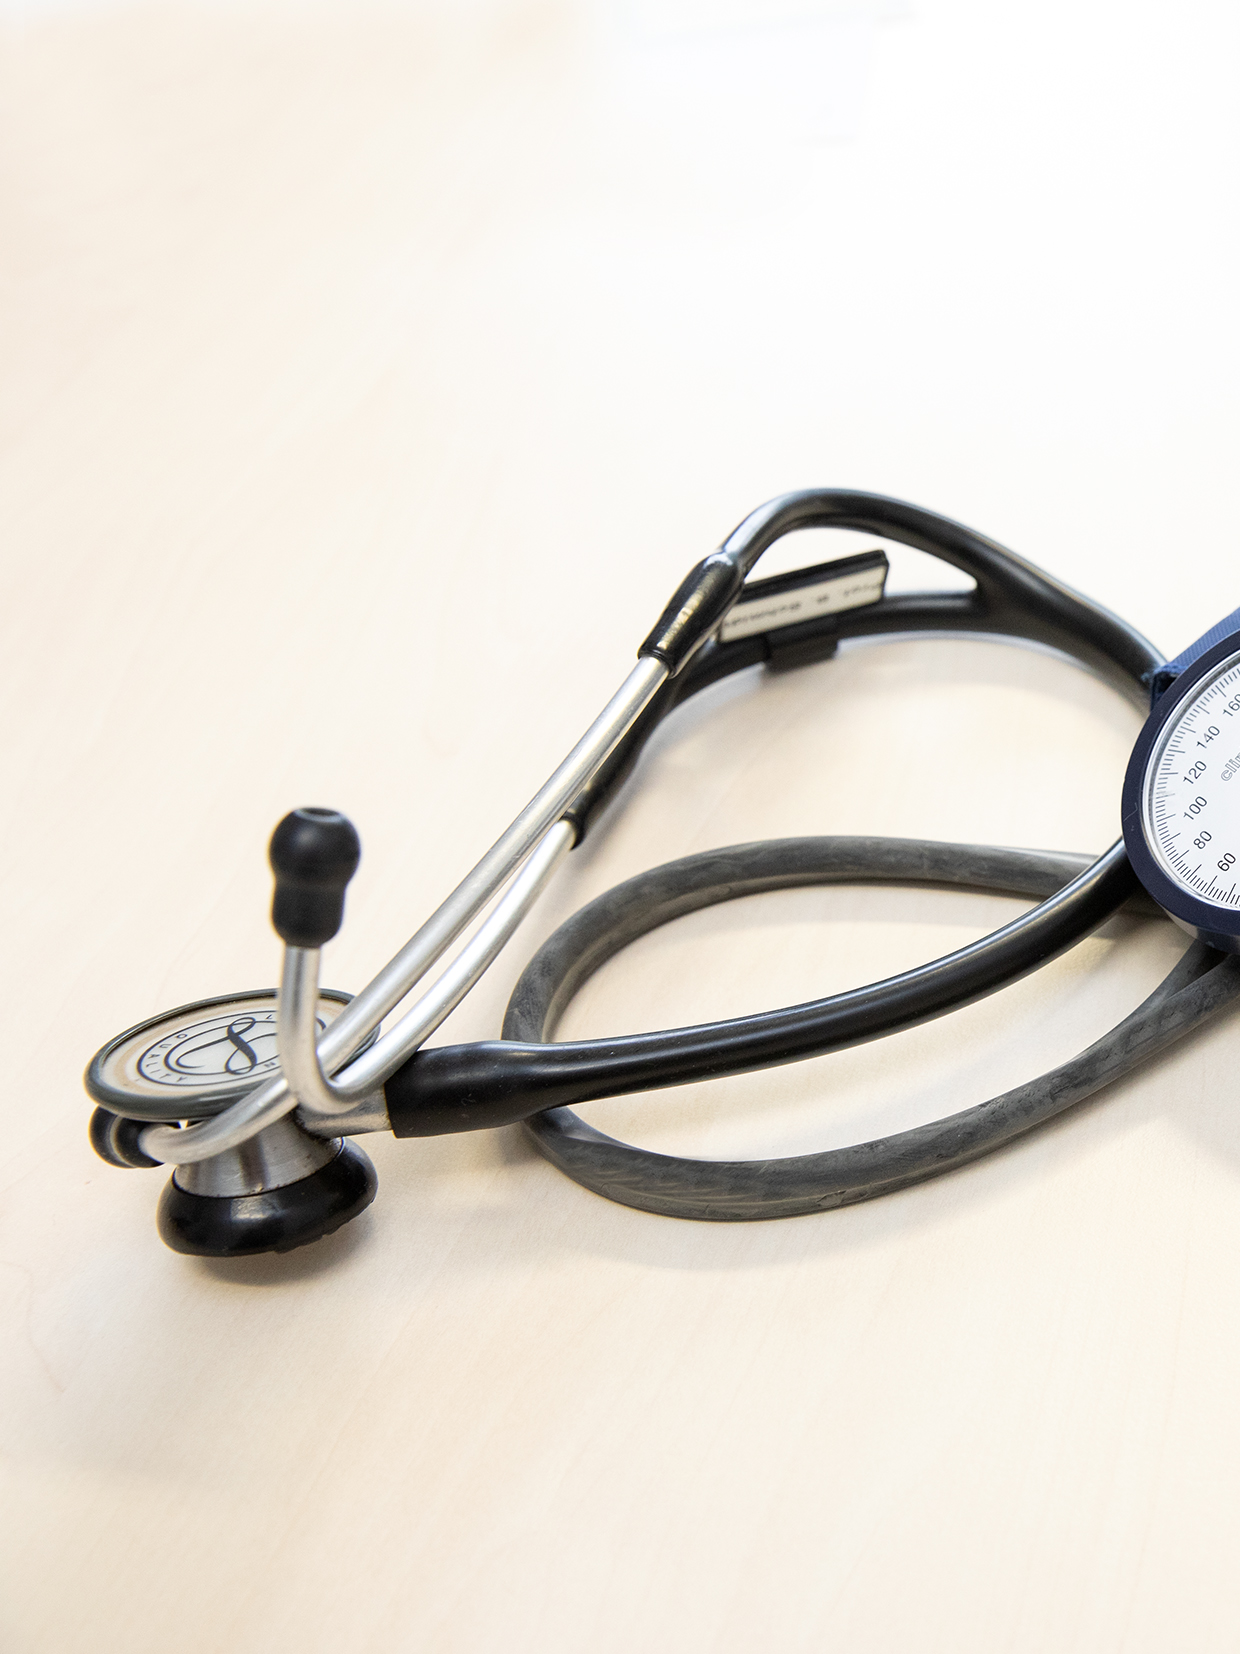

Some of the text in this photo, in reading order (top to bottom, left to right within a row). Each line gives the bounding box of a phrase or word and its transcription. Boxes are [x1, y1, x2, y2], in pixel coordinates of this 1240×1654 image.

[1195, 725, 1221, 749] 140
[1182, 760, 1207, 785] 120
[1183, 795, 1208, 821] 100
[1193, 830, 1213, 850] 80
[1216, 852, 1237, 872] 60
[145, 1033, 188, 1082] QUALITY
